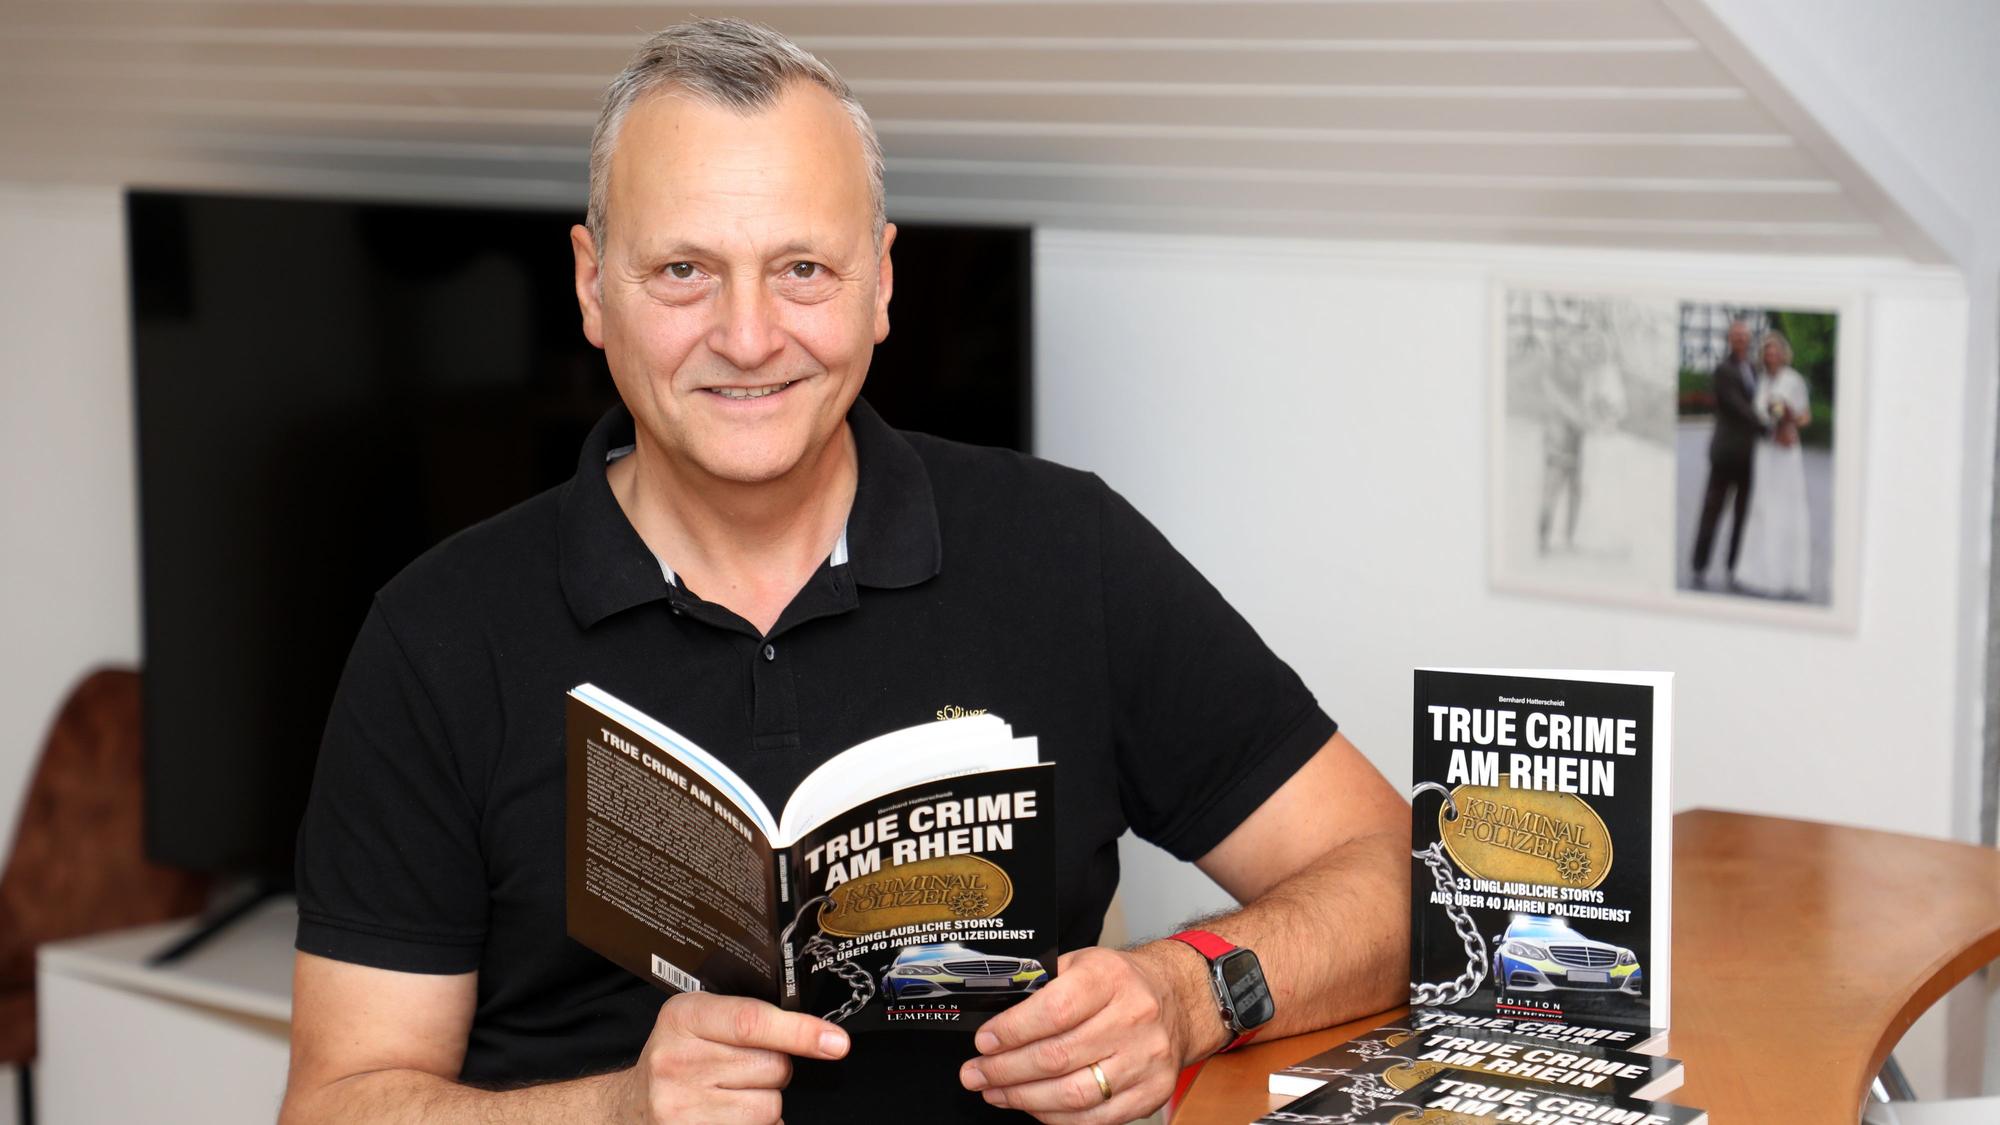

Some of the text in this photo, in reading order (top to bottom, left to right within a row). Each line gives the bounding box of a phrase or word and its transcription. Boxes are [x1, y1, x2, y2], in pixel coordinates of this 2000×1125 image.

[1499, 695, 1565, 707] Bernhard Hatterscheidt
[1427, 705, 1637, 756] TRUE CRIME
[601, 728, 753, 843] TRUE CRIME AM RHEIN
[1446, 748, 1615, 797] AM RHEIN
[805, 790, 1037, 874] TRUE CRIME
[1458, 816, 1560, 862] POLIZEI
[1463, 796, 1592, 849] KRIMINAL
[825, 848, 881, 892] AM
[893, 824, 1013, 867] RHEIN
[838, 889, 951, 918] POLIZEI
[846, 873, 988, 899] KRIMINAL
[1456, 877, 1604, 904] 33 UNGLAUBLICHE STORYS
[1430, 890, 1631, 923] AUS ÜBER 40 JAHREN POLIZEIDIENST
[811, 929, 1035, 974] AUS ÜBER 40 JAHREN POLIZEIDIENST
[838, 917, 1004, 951] 33 UNGLAUBLICHE STORYS
[887, 1012, 960, 1021] LEMPERTZ
[1496, 997, 1560, 1010] EDITION
[1420, 1013, 1514, 1029] TRUE
[1515, 1022, 1636, 1041] CRIME
[1417, 1049, 1608, 1088] AM RHEIN
[1424, 1034, 1524, 1058] TRUE
[1522, 1049, 1650, 1079] CRIME
[1425, 1095, 1499, 1117] AM
[1432, 1079, 1538, 1107] TRUE
[1536, 1097, 1671, 1125] CRIME
